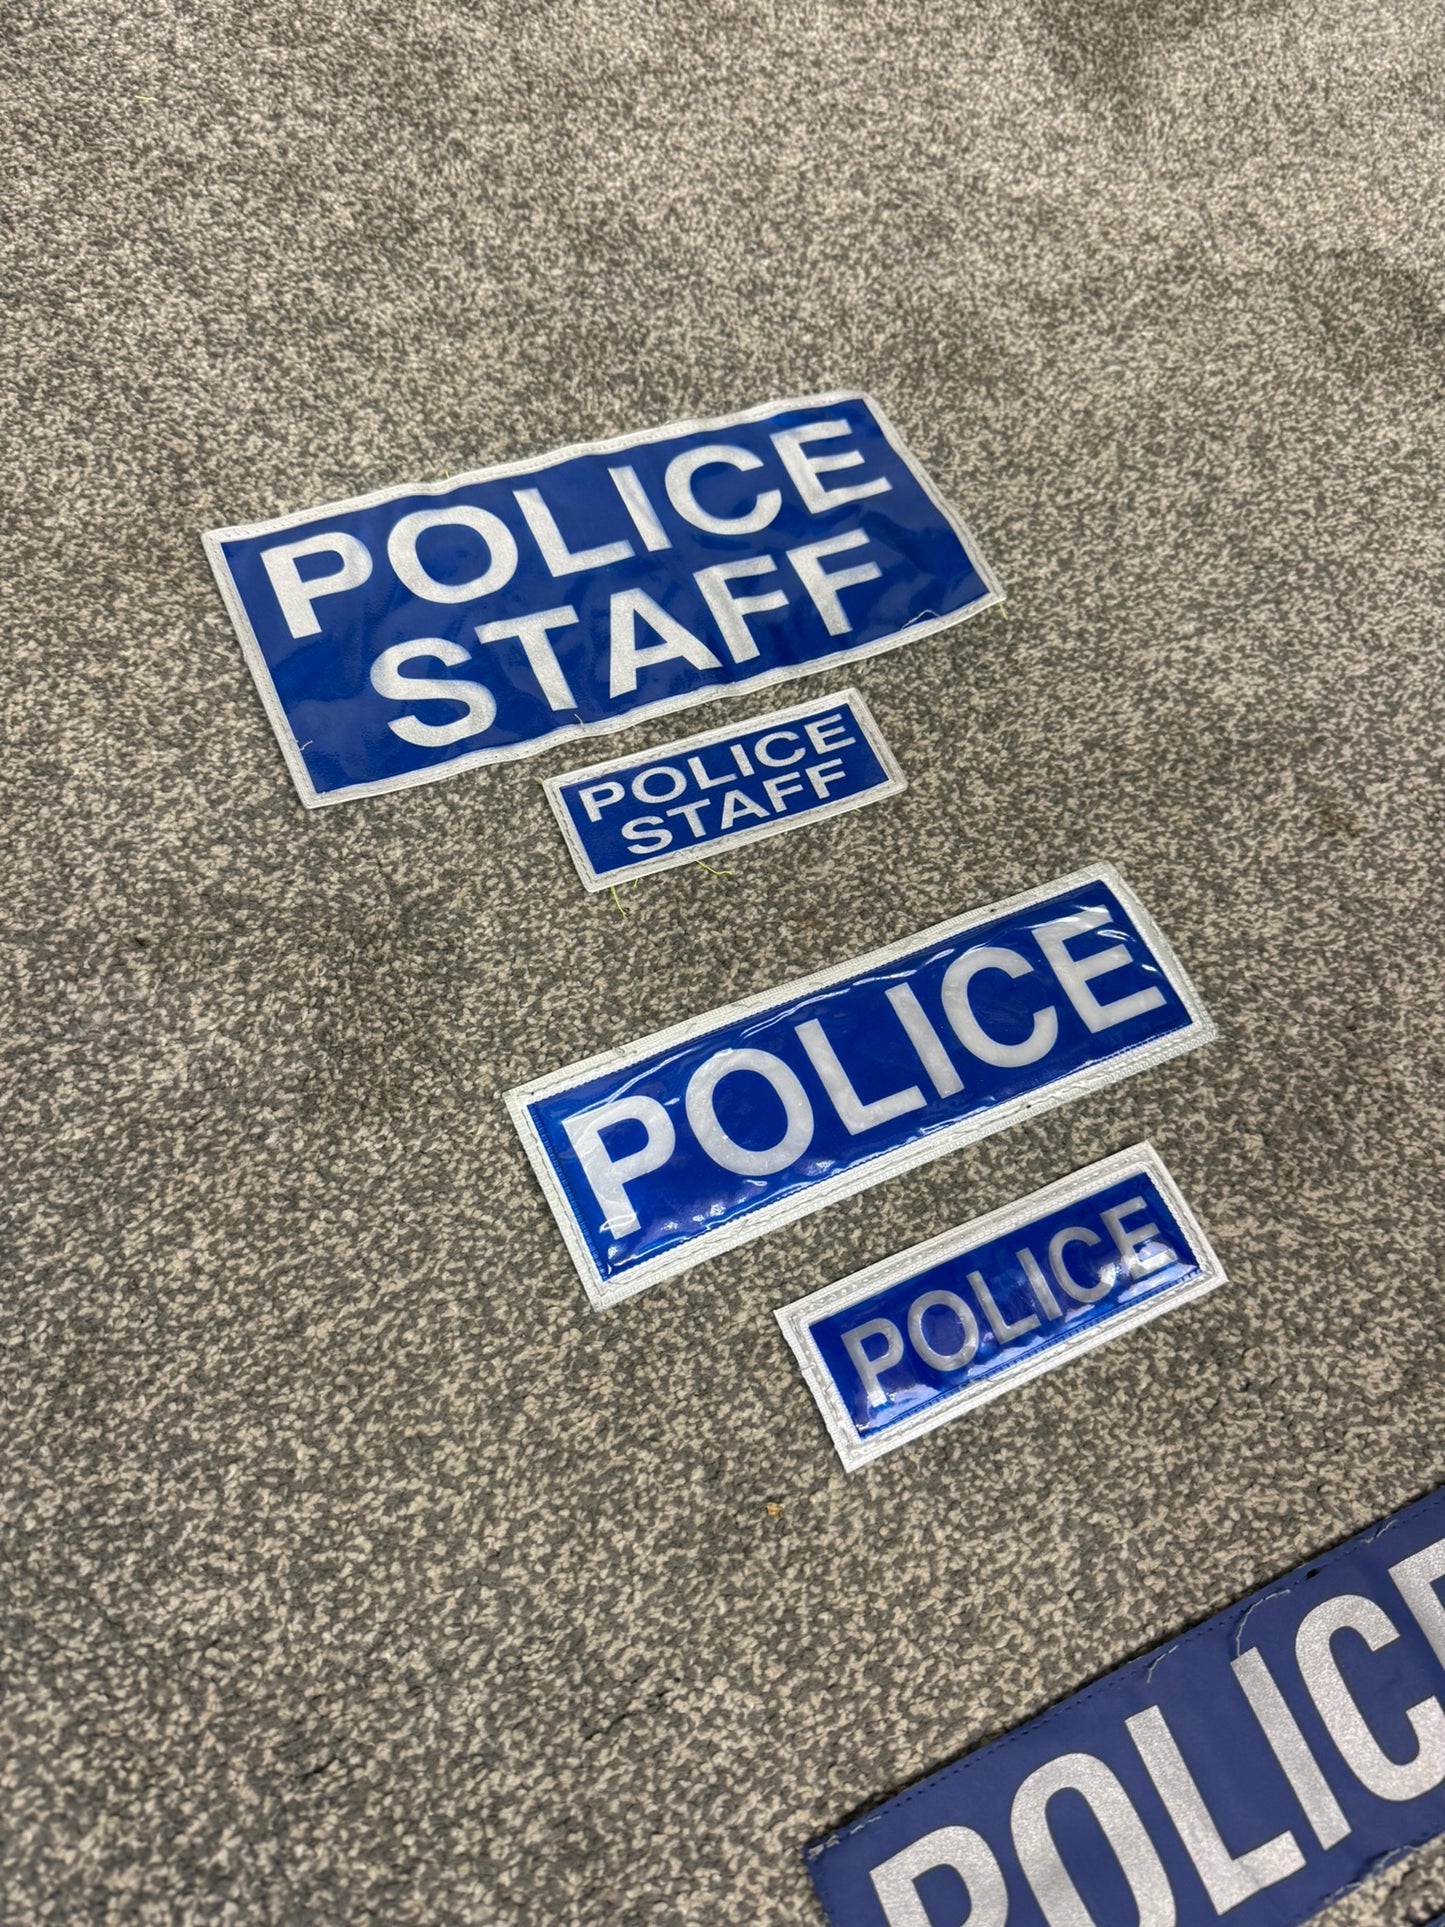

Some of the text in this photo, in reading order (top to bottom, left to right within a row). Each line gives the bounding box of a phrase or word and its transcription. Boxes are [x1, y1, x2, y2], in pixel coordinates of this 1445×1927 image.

[260, 420, 892, 639] POLICE
[371, 530, 881, 747] STAFF
[578, 714, 856, 822] POLICE
[621, 758, 846, 854] STAFF
[562, 905, 1167, 1240] POLICE
[842, 1196, 1178, 1408] POLICE
[869, 1537, 1445, 1927] OLIC
